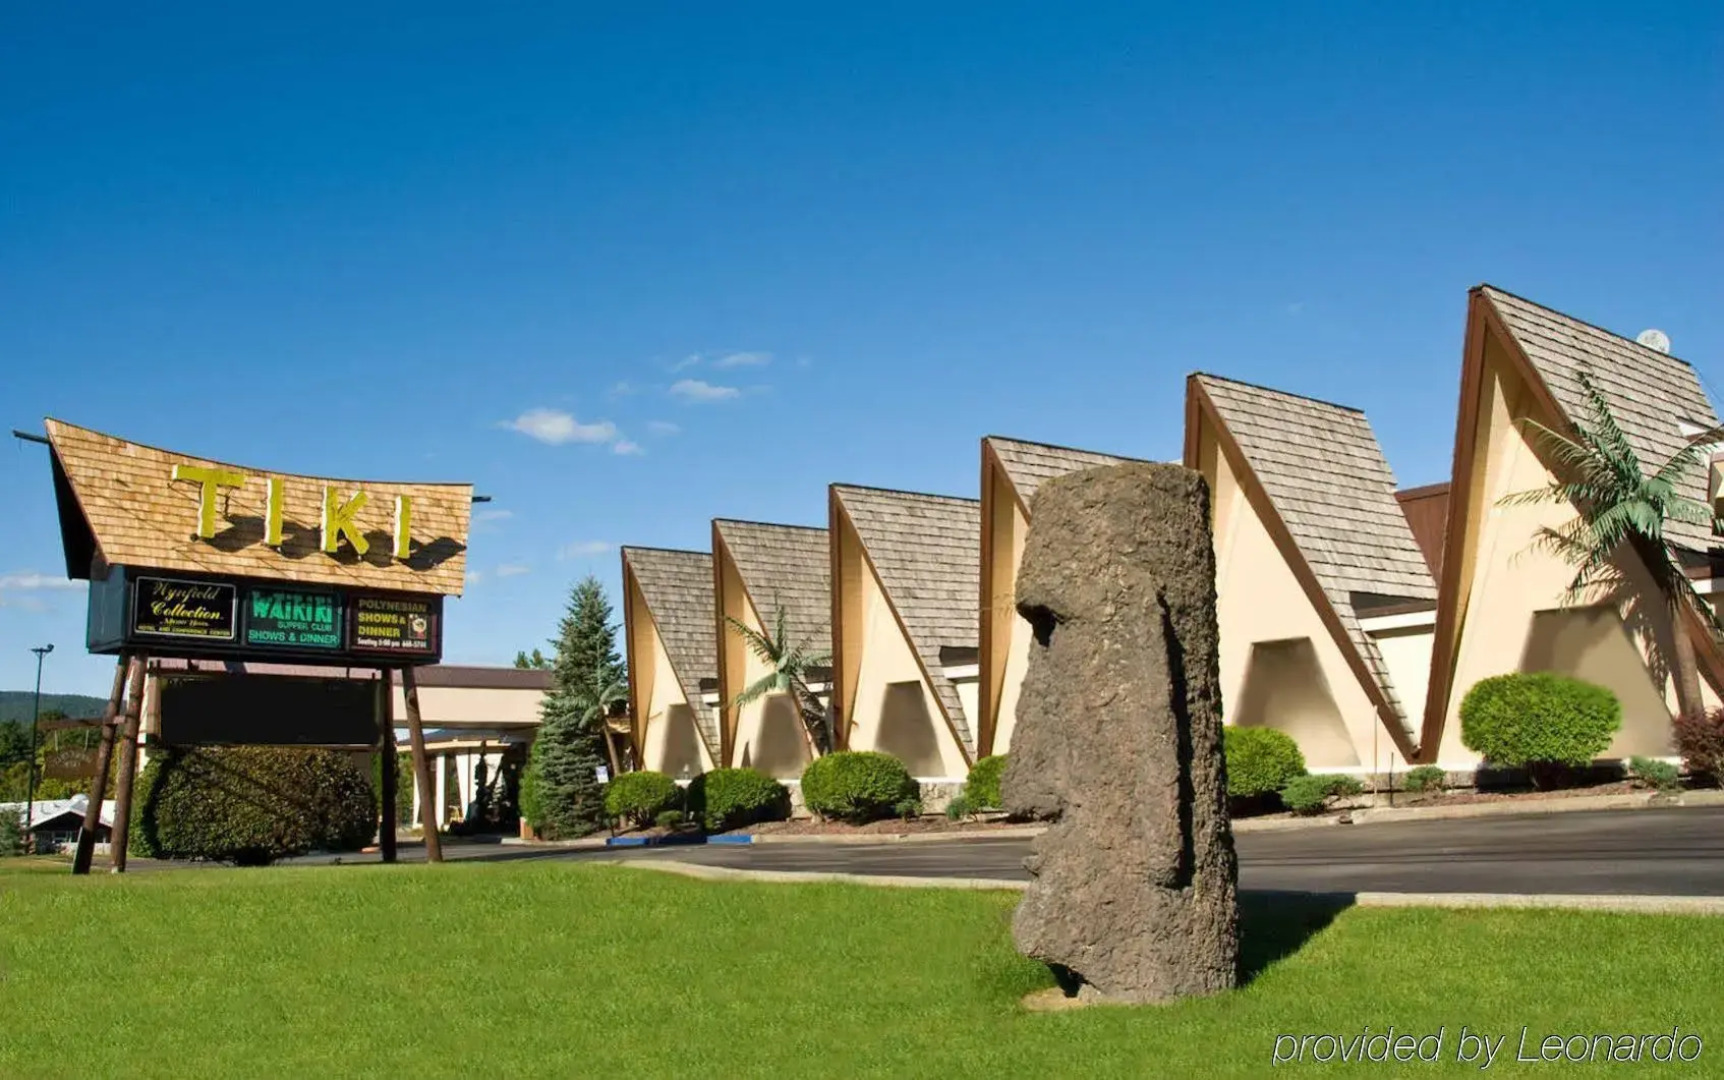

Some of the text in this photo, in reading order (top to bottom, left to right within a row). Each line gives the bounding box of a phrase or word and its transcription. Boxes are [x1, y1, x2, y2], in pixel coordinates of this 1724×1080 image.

[172, 464, 411, 559] TIKI
[151, 601, 221, 619] Collection
[252, 591, 333, 623] WAIKIKI
[359, 600, 427, 612] POLYNESIAN
[358, 612, 406, 625] SHOWS &
[277, 621, 332, 632] SUPPER CLUB
[358, 626, 401, 637] DINNER
[249, 629, 337, 645] SHOWS & DINNER
